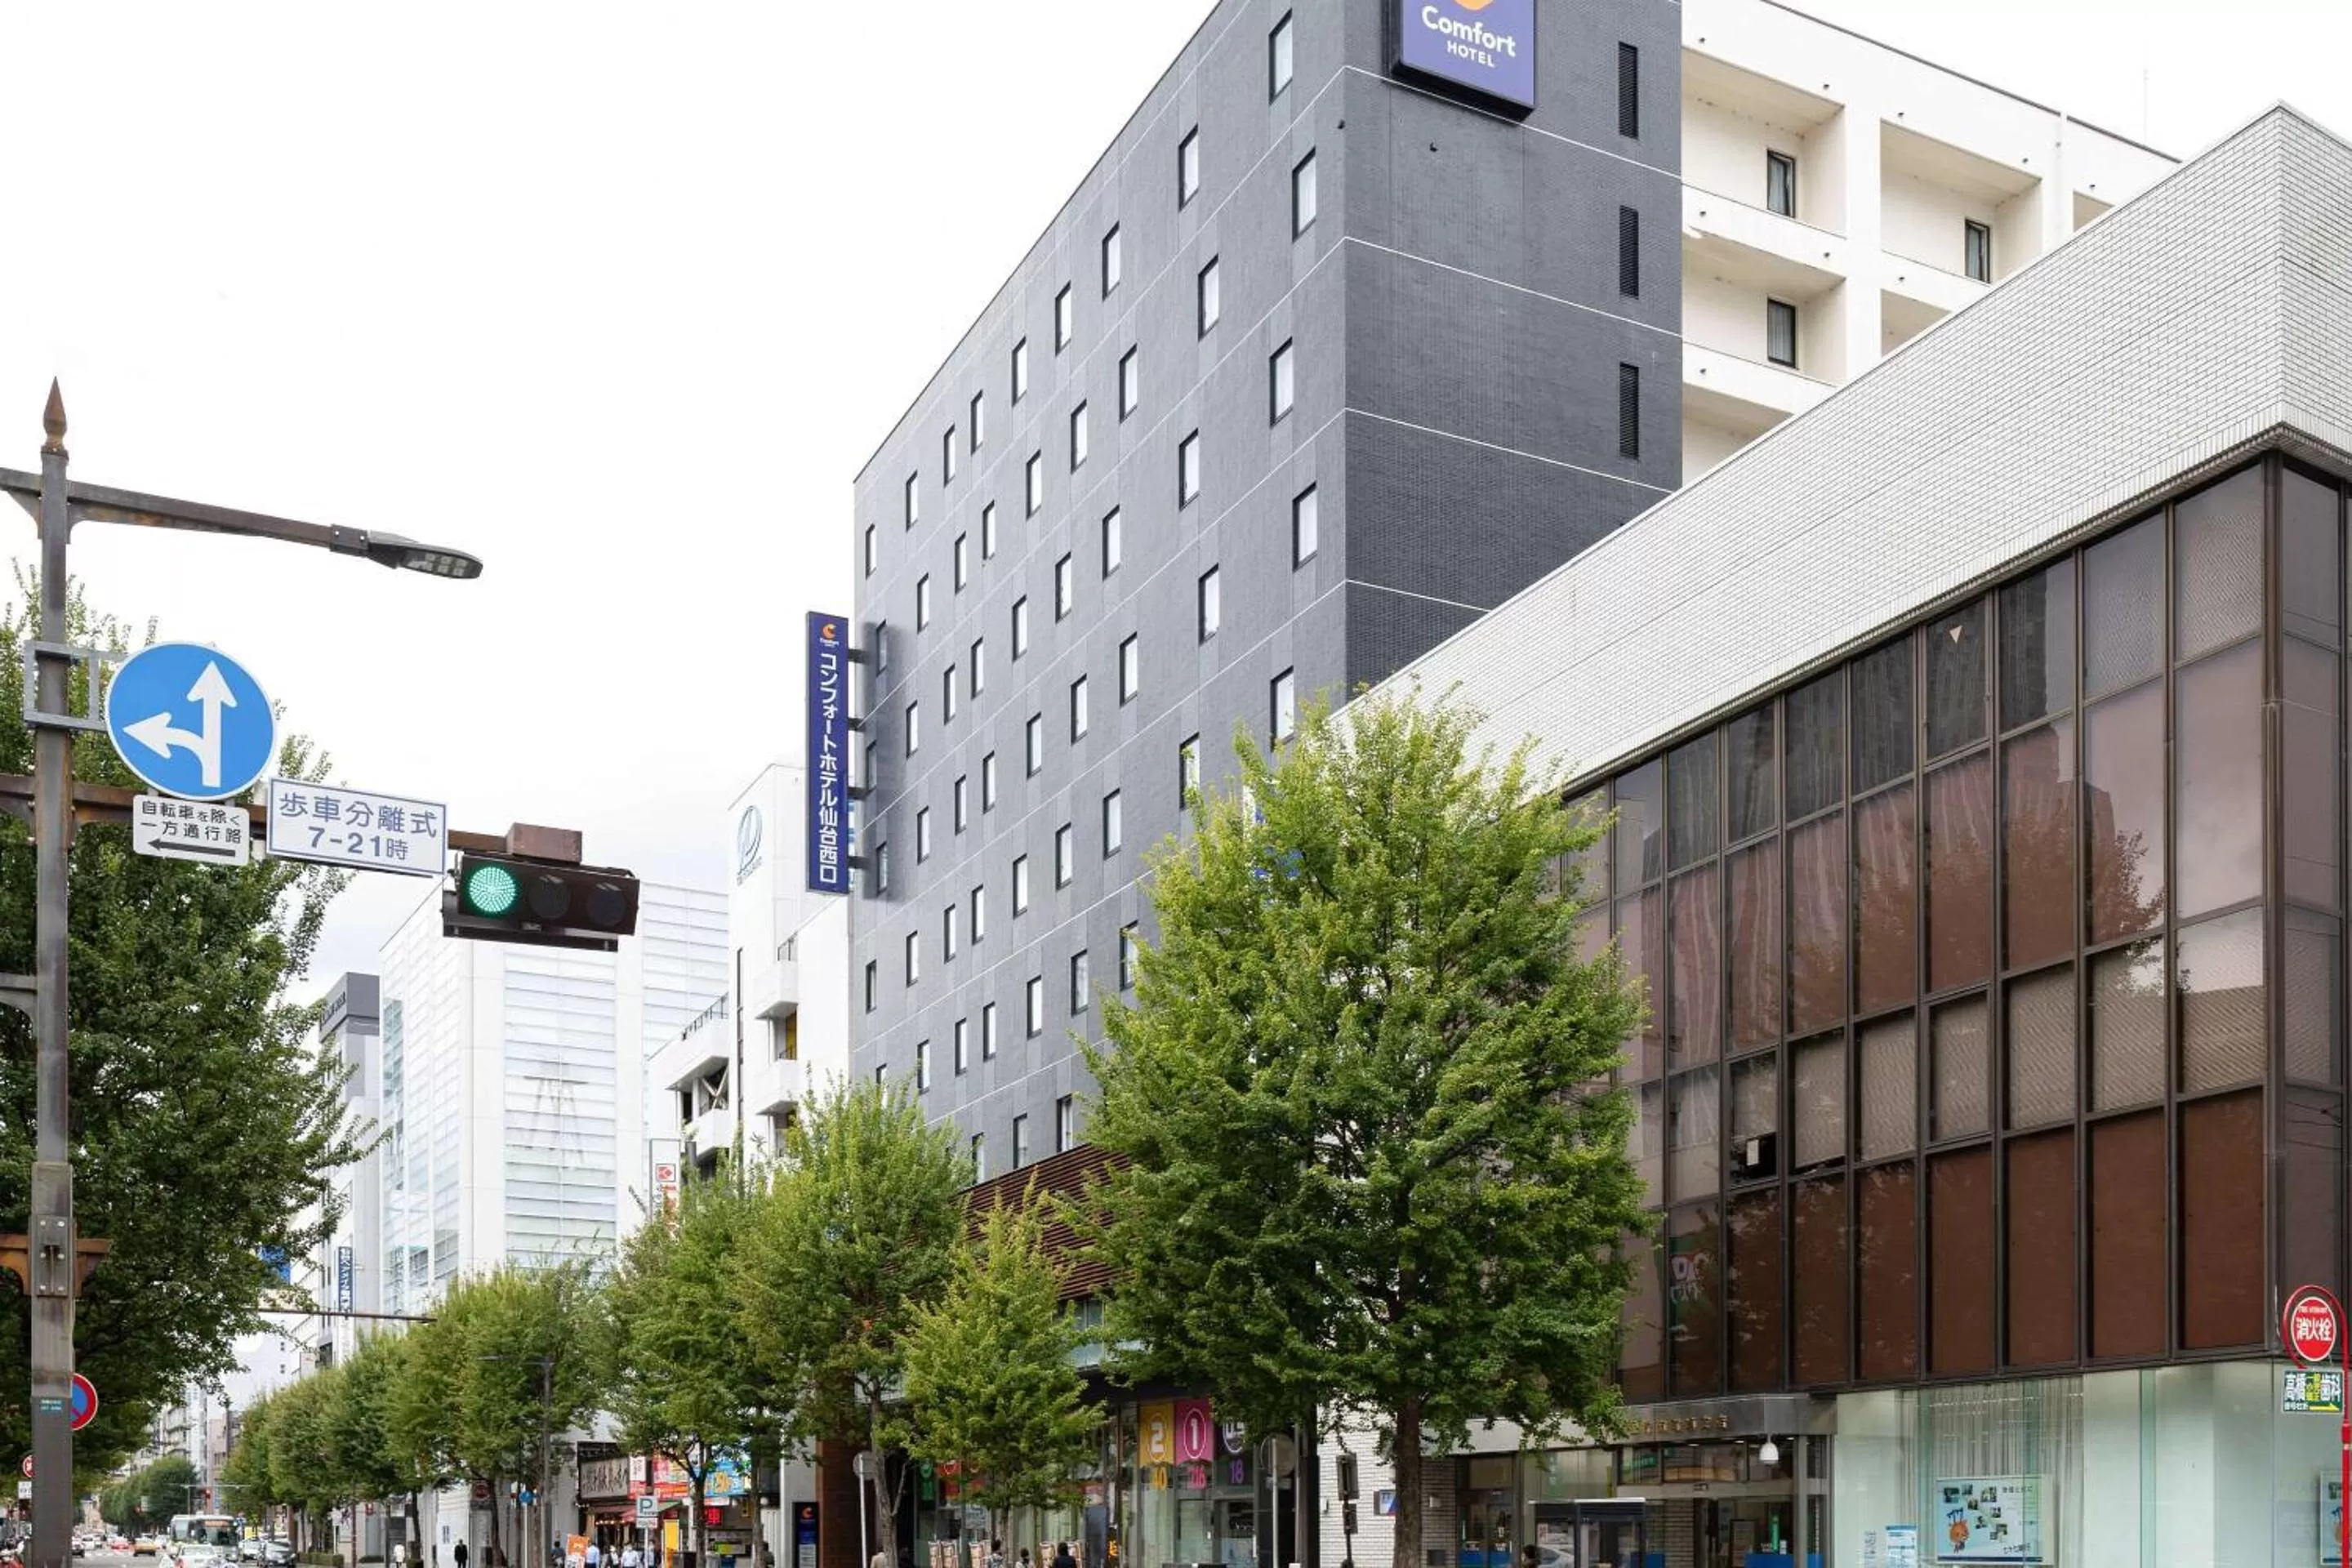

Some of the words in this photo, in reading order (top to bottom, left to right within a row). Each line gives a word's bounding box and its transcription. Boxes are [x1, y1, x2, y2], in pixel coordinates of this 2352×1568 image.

[1421, 5, 1517, 57] Comfort
[1446, 40, 1494, 68] HOTEL
[819, 653, 838, 883] コンフォートホテル仙台西口
[141, 800, 240, 826] 自転車を除く
[279, 791, 438, 838] 歩車分離式
[140, 819, 243, 844] 一方通行路
[308, 826, 408, 861] 7-21時
[2296, 1317, 2332, 1342] 消火栓
[1151, 1421, 1165, 1454] 2
[1190, 1418, 1198, 1450] 1
[639, 1498, 653, 1514] P
